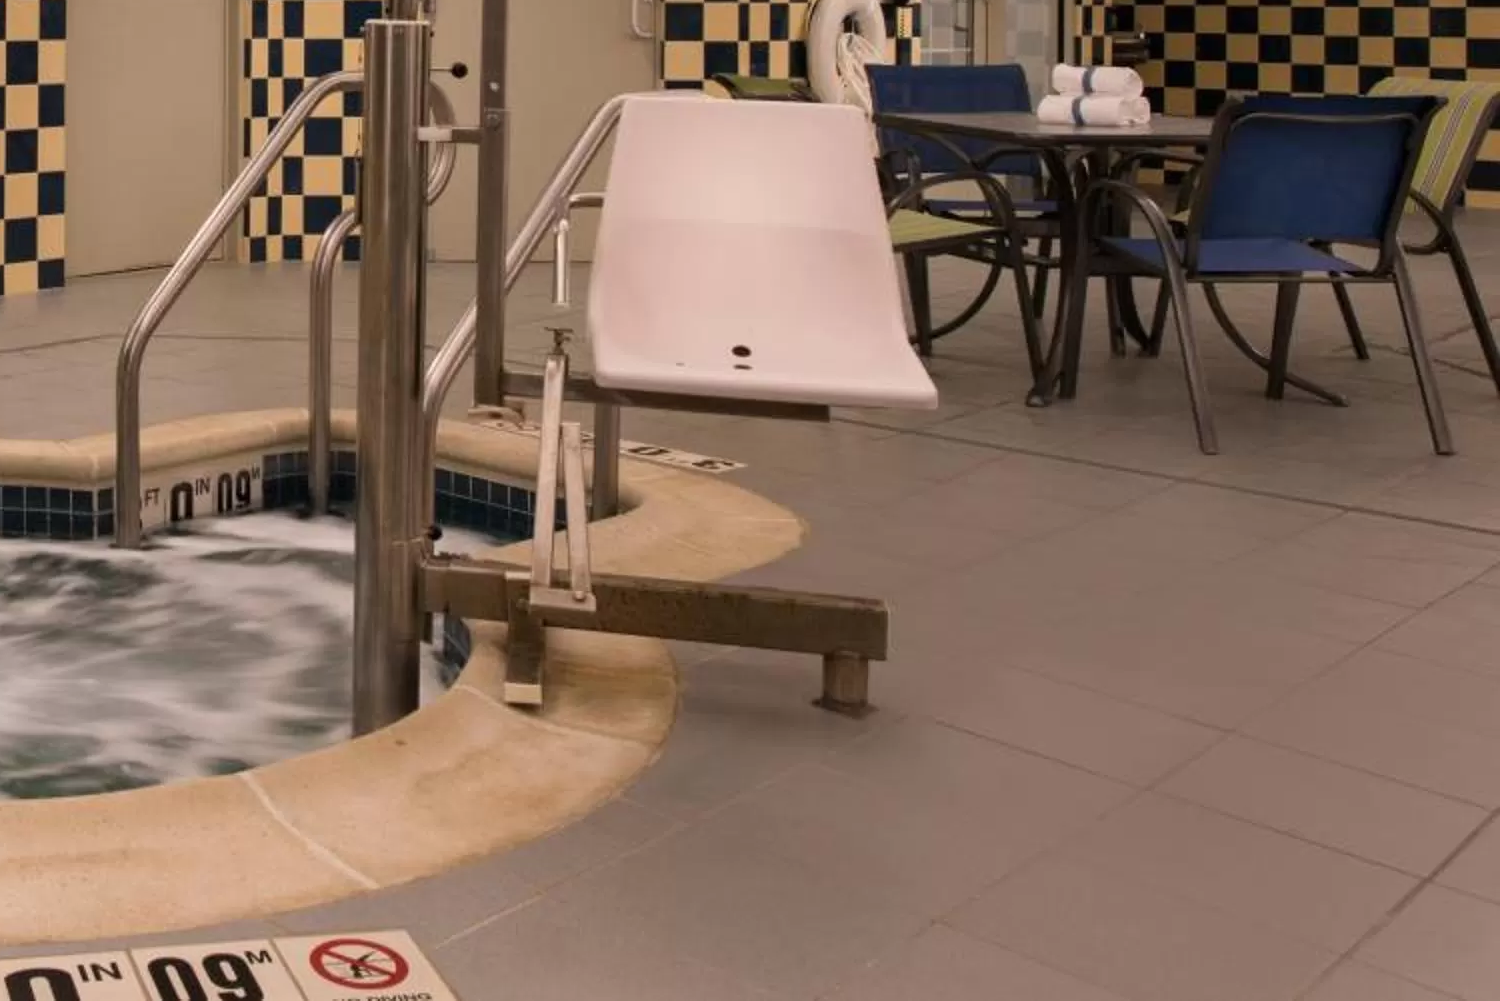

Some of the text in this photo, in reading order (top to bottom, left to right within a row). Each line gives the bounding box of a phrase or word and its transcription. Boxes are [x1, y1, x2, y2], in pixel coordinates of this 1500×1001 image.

[144, 487, 160, 507] FT
[170, 481, 194, 522] 0
[195, 478, 210, 496] IN
[77, 962, 123, 983] IN
[244, 950, 272, 965] M
